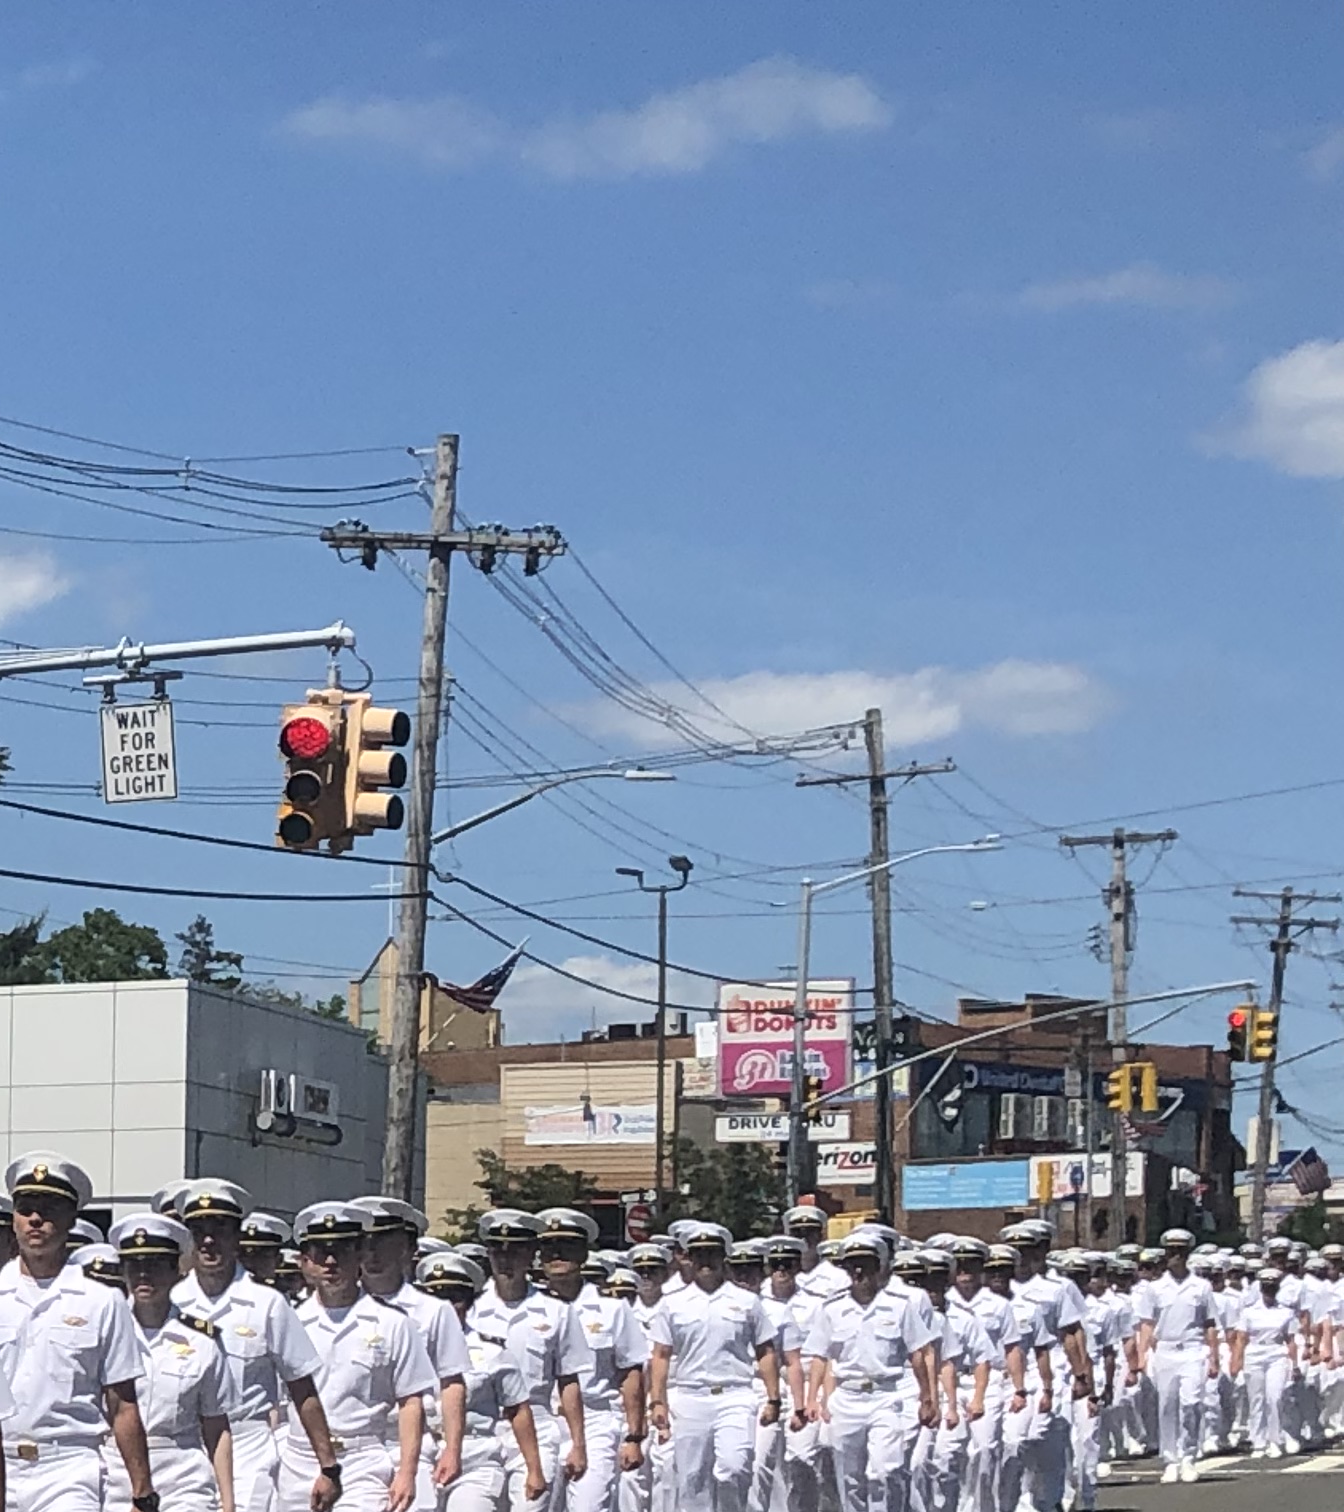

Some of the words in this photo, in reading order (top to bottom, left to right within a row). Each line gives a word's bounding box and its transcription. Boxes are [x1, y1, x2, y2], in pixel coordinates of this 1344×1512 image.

[116, 710, 157, 729] WAIT
[120, 731, 156, 752] FOR
[109, 752, 169, 774] GREEN
[114, 773, 166, 796] LIGHT
[728, 1117, 782, 1130] DRIVE
[816, 1146, 878, 1169] erizon
